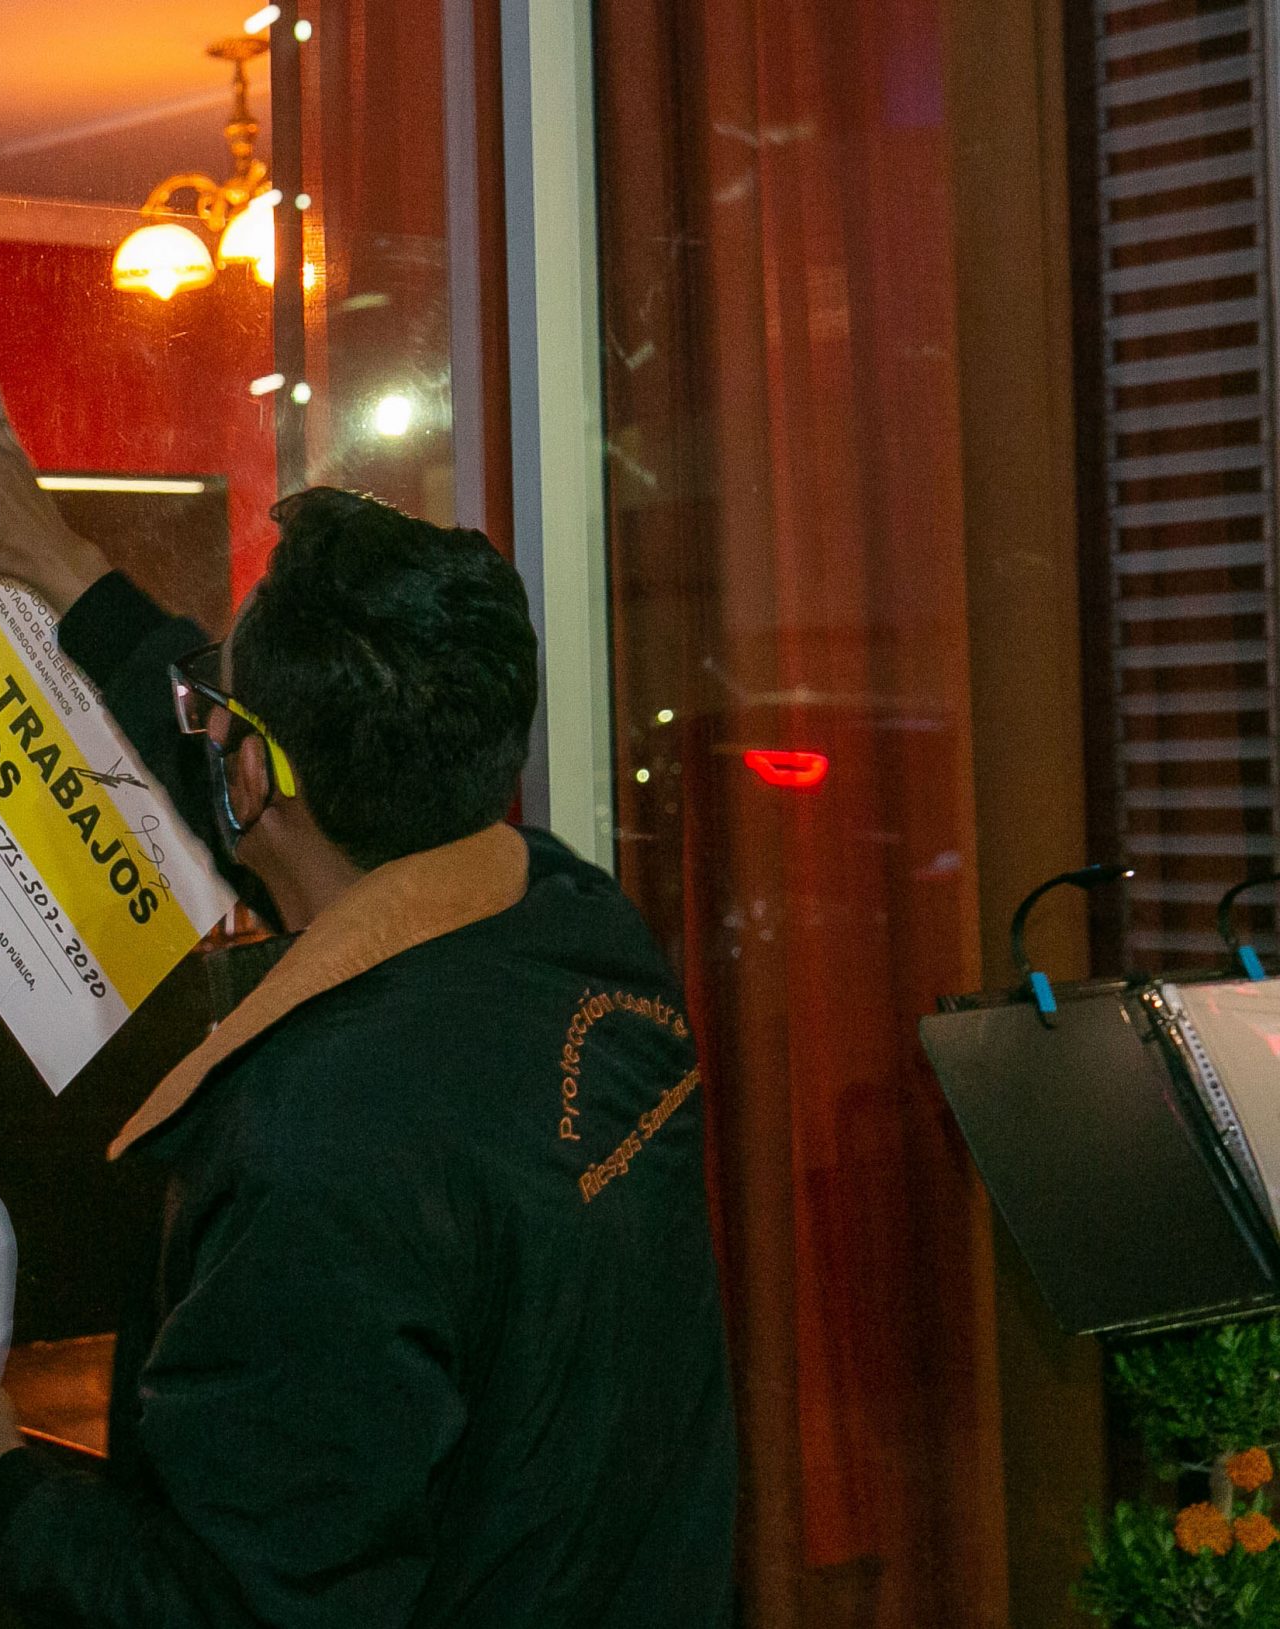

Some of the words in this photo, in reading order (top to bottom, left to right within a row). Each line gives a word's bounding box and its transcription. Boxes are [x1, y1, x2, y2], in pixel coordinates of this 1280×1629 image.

[8, 617, 37, 660] RIESGOS
[35, 660, 72, 715] SANITARIOS
[30, 622, 45, 641] DE
[43, 641, 90, 712] QUERÉTARO
[7, 947, 35, 991] PÚBLICA,
